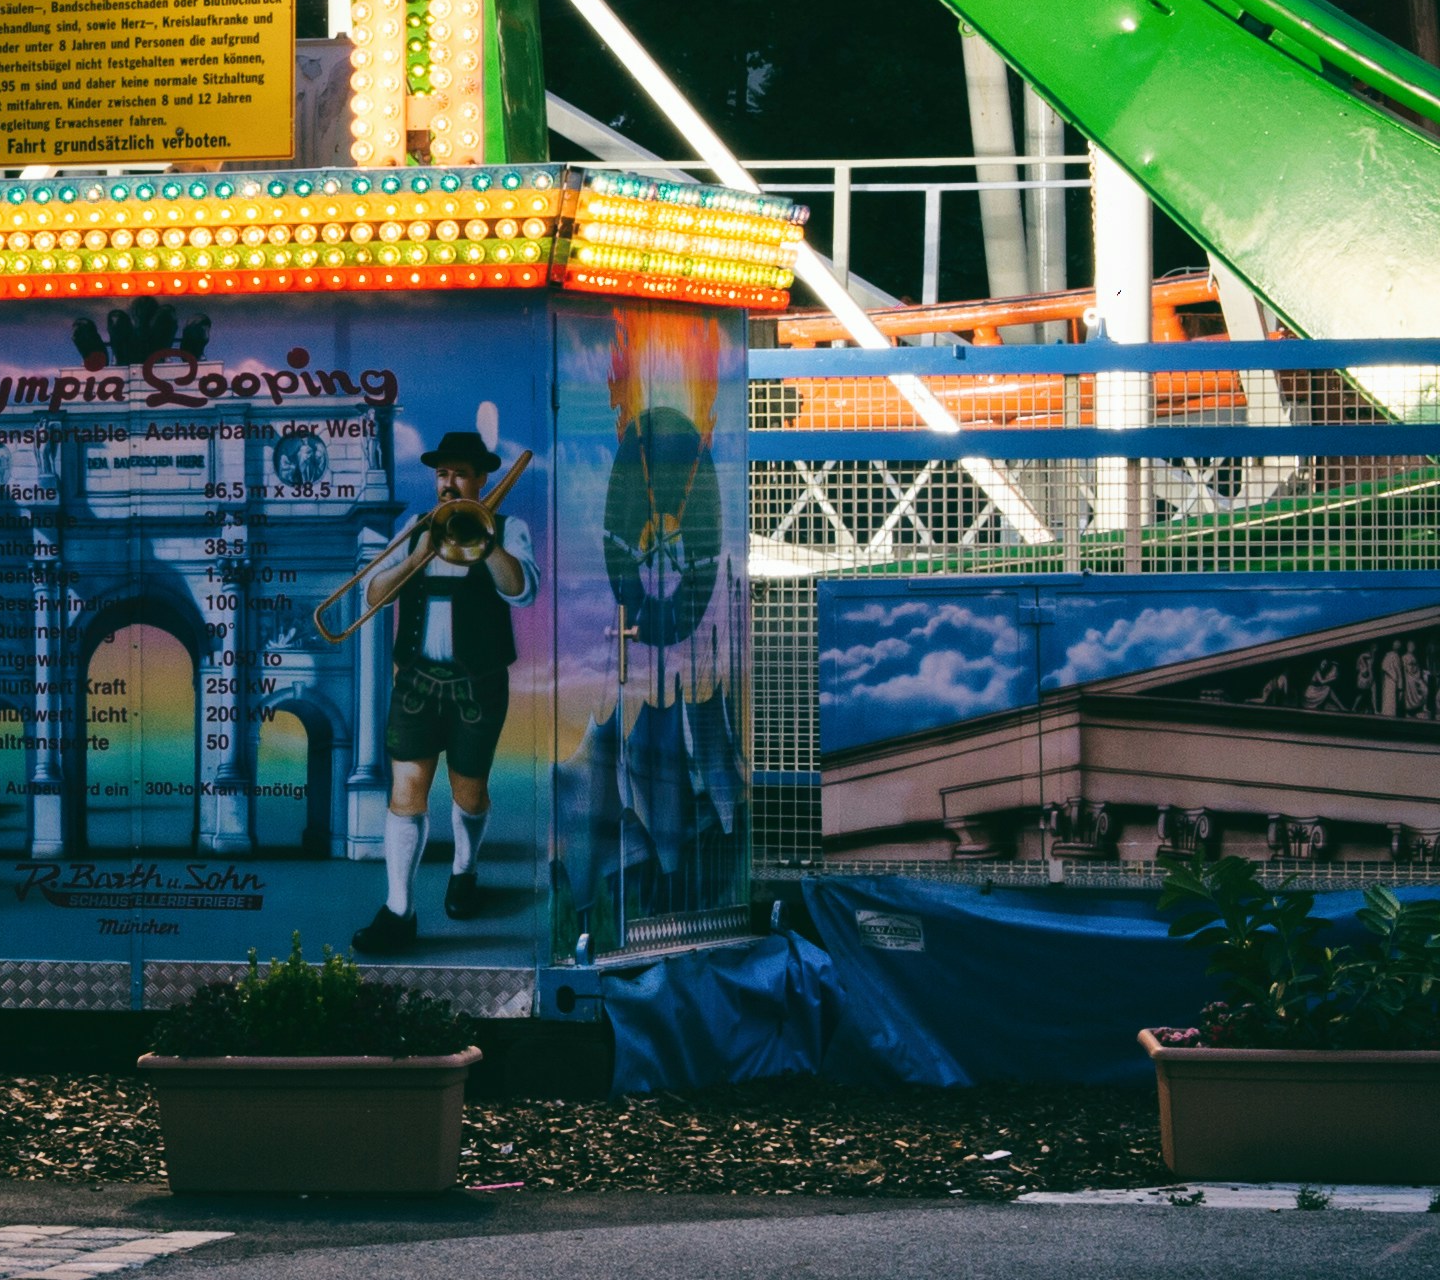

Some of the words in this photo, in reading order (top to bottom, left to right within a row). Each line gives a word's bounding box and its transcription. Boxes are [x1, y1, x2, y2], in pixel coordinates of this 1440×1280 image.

[56, 20, 81, 33] sind,
[86, 18, 116, 31] sowie
[162, 13, 248, 28] Kreislaufkranke
[253, 12, 273, 24] und
[25, 41, 53, 52] unter
[59, 39, 66, 52] 8
[72, 39, 106, 51] Jahren
[111, 37, 130, 49] und
[135, 36, 185, 48] Personen
[189, 34, 206, 46] die
[211, 32, 260, 47] aufgrund
[76, 58, 102, 70] nicht
[107, 56, 175, 70] festgehalten
[180, 54, 219, 66] werden
[224, 52, 265, 65] können,
[21, 83, 30, 91] m
[35, 79, 57, 91] sind
[62, 78, 81, 90] und
[86, 77, 116, 89] daher
[121, 76, 149, 88] keine
[154, 74, 198, 87] normale
[203, 72, 265, 85] Sitzhaltung
[7, 99, 62, 111] mitfahren.
[67, 97, 102, 109] Kinder
[107, 95, 156, 108] zwischen
[161, 94, 169, 106] 8
[174, 93, 193, 106] und
[198, 92, 211, 105] 12
[217, 92, 252, 104] Jahren
[55, 117, 124, 129] Erwachsener
[129, 115, 167, 126] fahren.
[7, 138, 46, 154] Fahrt
[54, 134, 154, 156] grundsätzlich
[162, 133, 231, 149] verboten.
[142, 347, 398, 407] Looping
[145, 420, 275, 440] Achterbahn
[282, 419, 319, 438] der
[326, 419, 376, 437] Welt
[176, 454, 204, 468] HEERE
[204, 482, 244, 500] 86,5
[274, 486, 284, 497] x
[291, 481, 330, 500] 38,5
[338, 485, 355, 497] m
[204, 538, 244, 556] 38,5
[280, 569, 297, 582] m
[206, 594, 238, 610] 100
[246, 594, 291, 610] km/h
[264, 651, 282, 666] to
[80, 678, 126, 695] Kraft
[206, 678, 239, 694] 250
[206, 706, 240, 722] 200
[206, 734, 229, 750] 50
[105, 783, 129, 796] ein
[185, 865, 266, 890] Sohn
